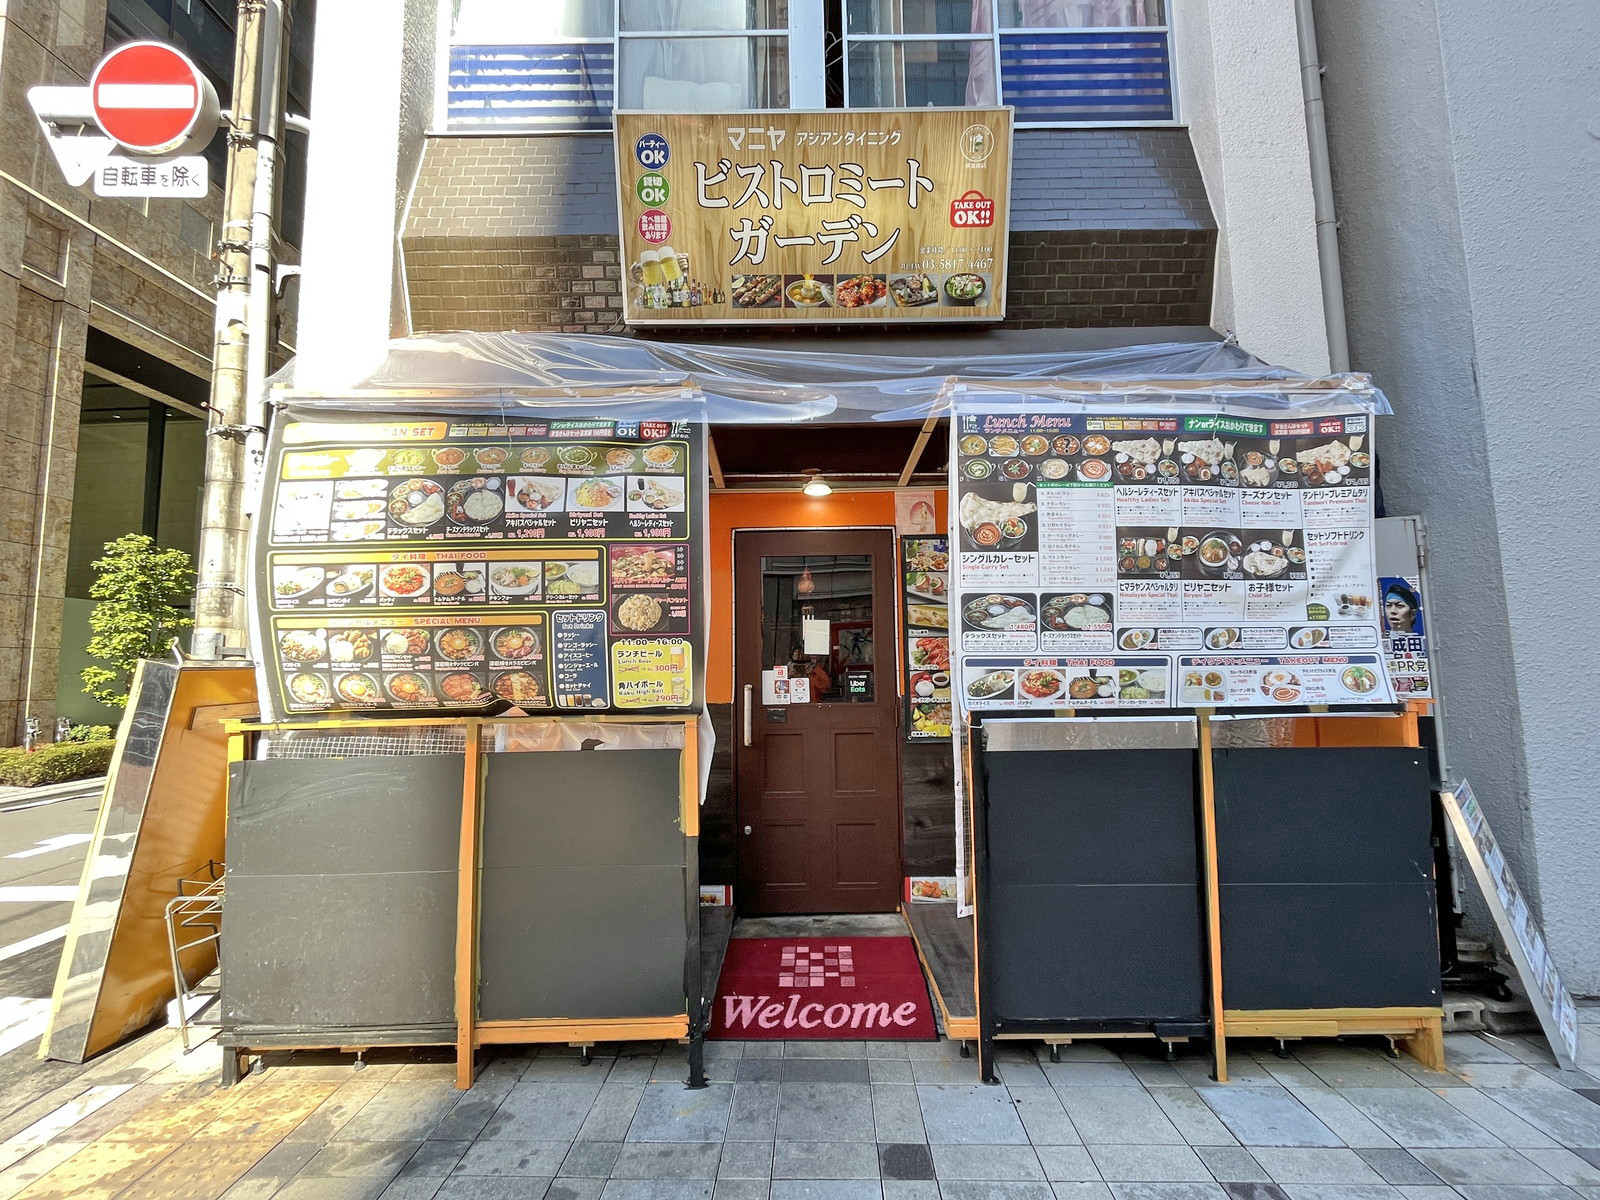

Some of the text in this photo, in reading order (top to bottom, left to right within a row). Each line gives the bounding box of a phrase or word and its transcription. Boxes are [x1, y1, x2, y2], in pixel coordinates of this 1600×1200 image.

[727, 126, 904, 157] マニヤ アジアンダイニング
[640, 149, 666, 165] OK
[102, 166, 201, 188] 自転車を除く
[694, 157, 935, 211] ビストロミート
[641, 187, 666, 203] OK
[954, 201, 992, 209] TAKE OUT
[953, 210, 991, 225] OK!!
[729, 214, 902, 272] ガーデン
[983, 413, 1028, 429] Lunch
[1030, 414, 1072, 429] Menu
[411, 427, 440, 438] SET
[617, 427, 637, 437] OK
[642, 428, 667, 438] OK!!
[1116, 487, 1179, 498] ヘルシーレディースセット
[1183, 488, 1236, 499] アキバスペシャルセット
[1241, 490, 1293, 500] チーズナンセット
[1302, 488, 1368, 500] タンドリープレミアムタリ
[1307, 530, 1365, 541] セットソフトドリンク
[434, 551, 487, 560] THAI FOOD
[962, 554, 1035, 563] シングルカレーセット
[1119, 582, 1179, 593] ヒマラヤンスペシャルタリ
[1183, 583, 1232, 593] ビリヤニセット
[1248, 582, 1294, 593] お子様セット
[413, 617, 481, 625] SPECIAL MENU
[964, 632, 1007, 640] デラックスセット
[1392, 636, 1422, 653] 成田
[617, 650, 663, 658] ランチビール
[1023, 659, 1058, 667] タイ料理
[1090, 659, 1115, 667] FOOD
[1277, 656, 1349, 665] TAKEOUT MENU
[618, 681, 664, 690] 角ハイボール
[849, 680, 866, 688] Uber
[722, 994, 918, 1030] Welcome
